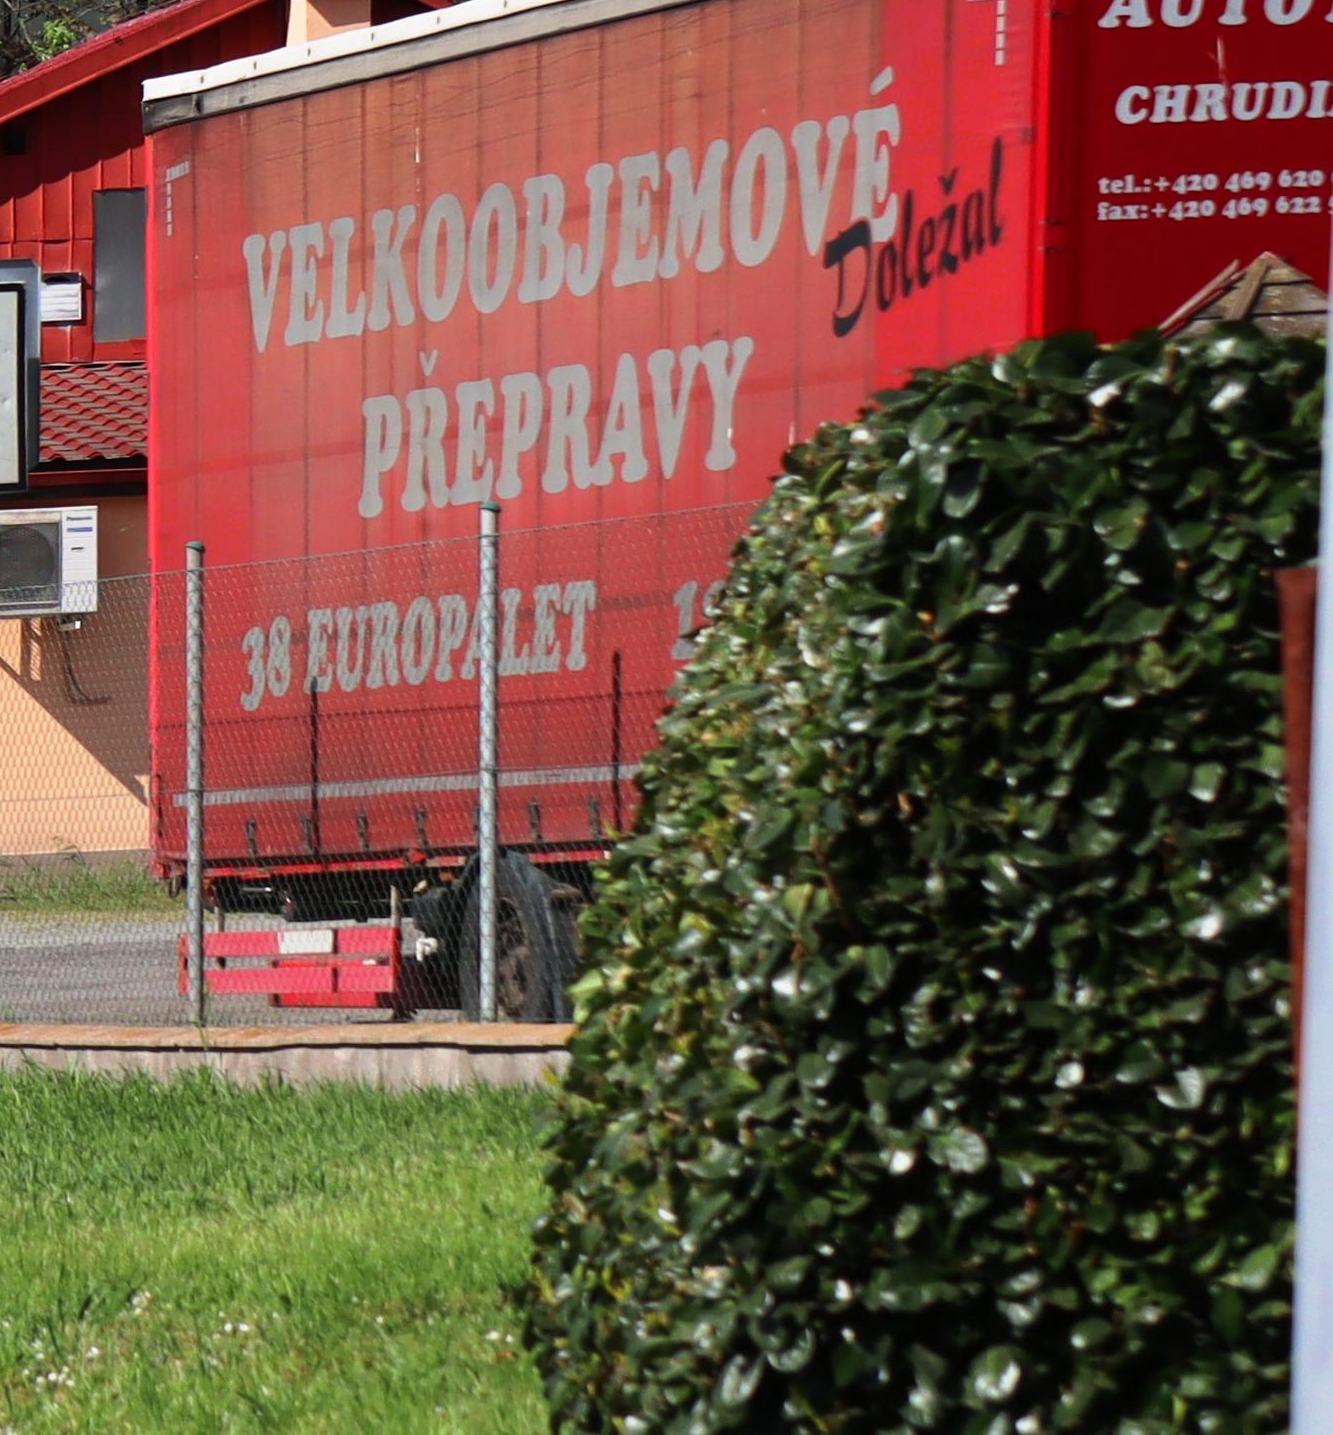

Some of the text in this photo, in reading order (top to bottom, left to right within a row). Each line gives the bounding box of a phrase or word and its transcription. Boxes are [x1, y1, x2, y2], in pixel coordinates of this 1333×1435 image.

[1114, 80, 1333, 125] CHRUDI
[242, 66, 901, 353] VELKOOBJEMOVÉ
[1221, 197, 1268, 219] 469
[1275, 196, 1321, 214] 622
[1224, 170, 1271, 192] 469
[1277, 169, 1324, 188] 620
[823, 136, 1003, 337] Doležal
[358, 336, 754, 518] PŘEPRAVY
[241, 616, 291, 711] 38
